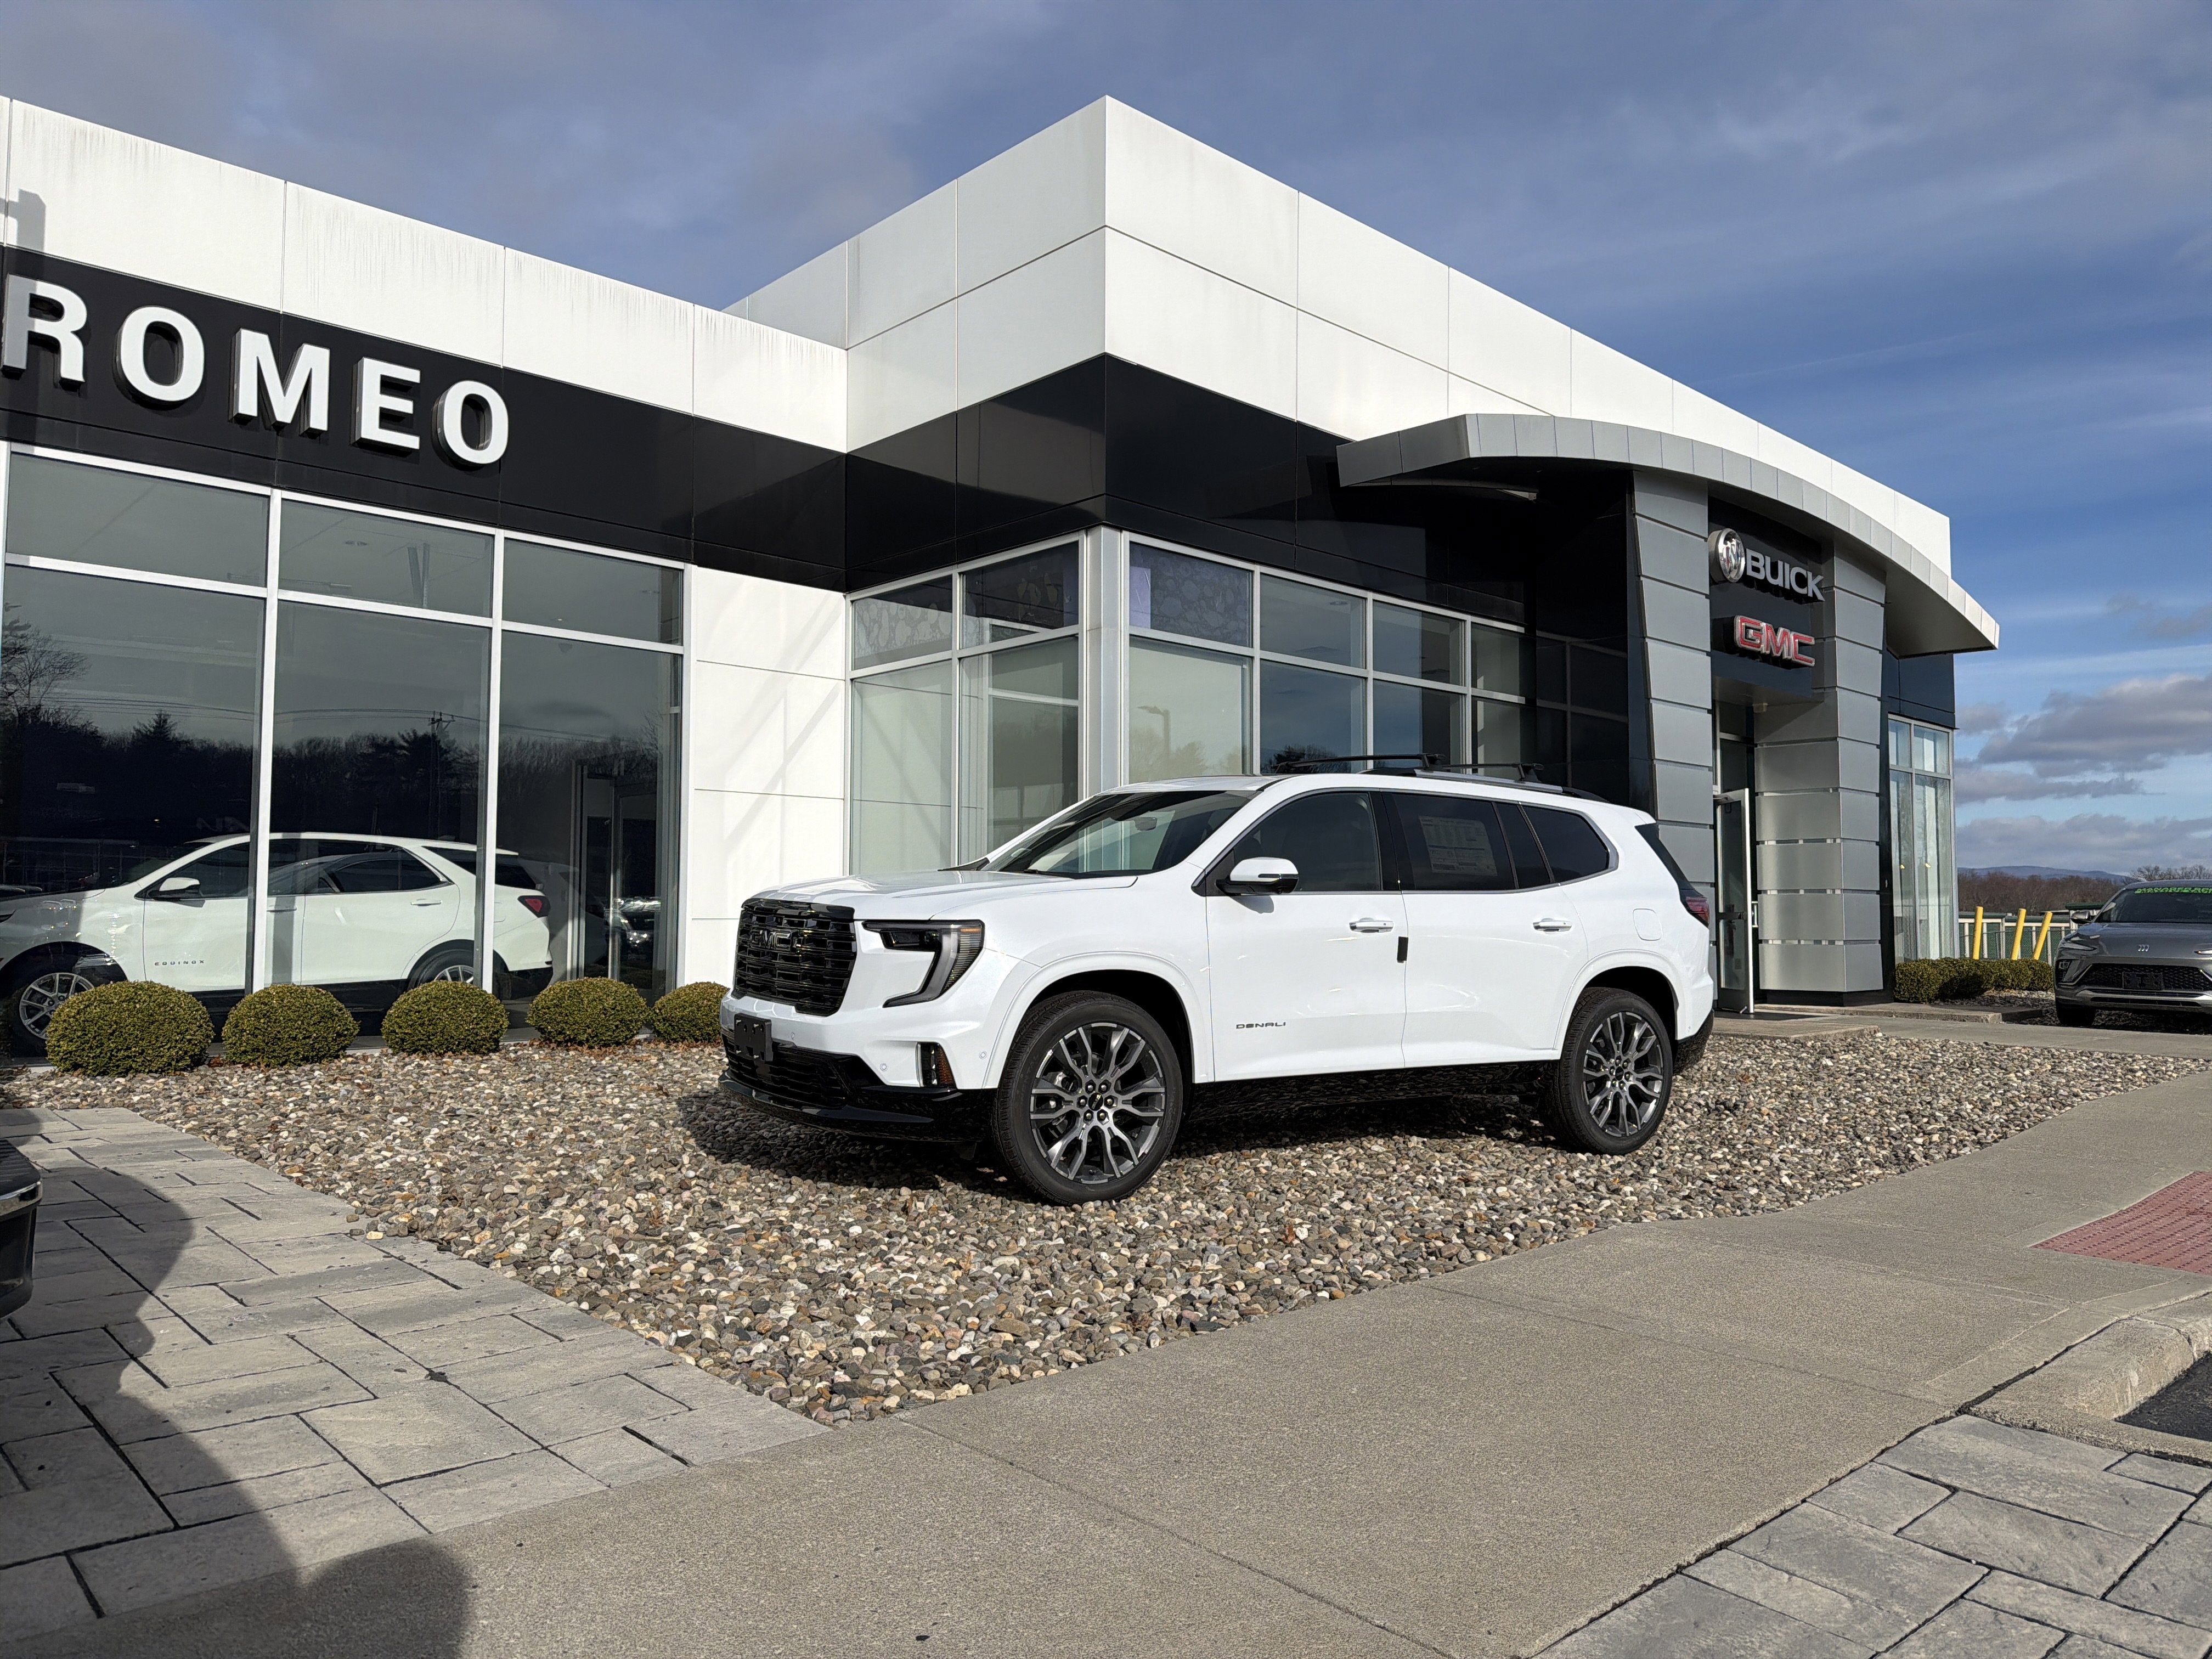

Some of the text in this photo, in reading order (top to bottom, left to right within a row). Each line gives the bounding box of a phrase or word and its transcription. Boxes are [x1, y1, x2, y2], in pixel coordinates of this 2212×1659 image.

[2, 273, 509, 465] ROMEO
[1746, 548, 1825, 601] BUICK
[1734, 615, 1815, 667] GMC
[750, 929, 791, 951] GMC
